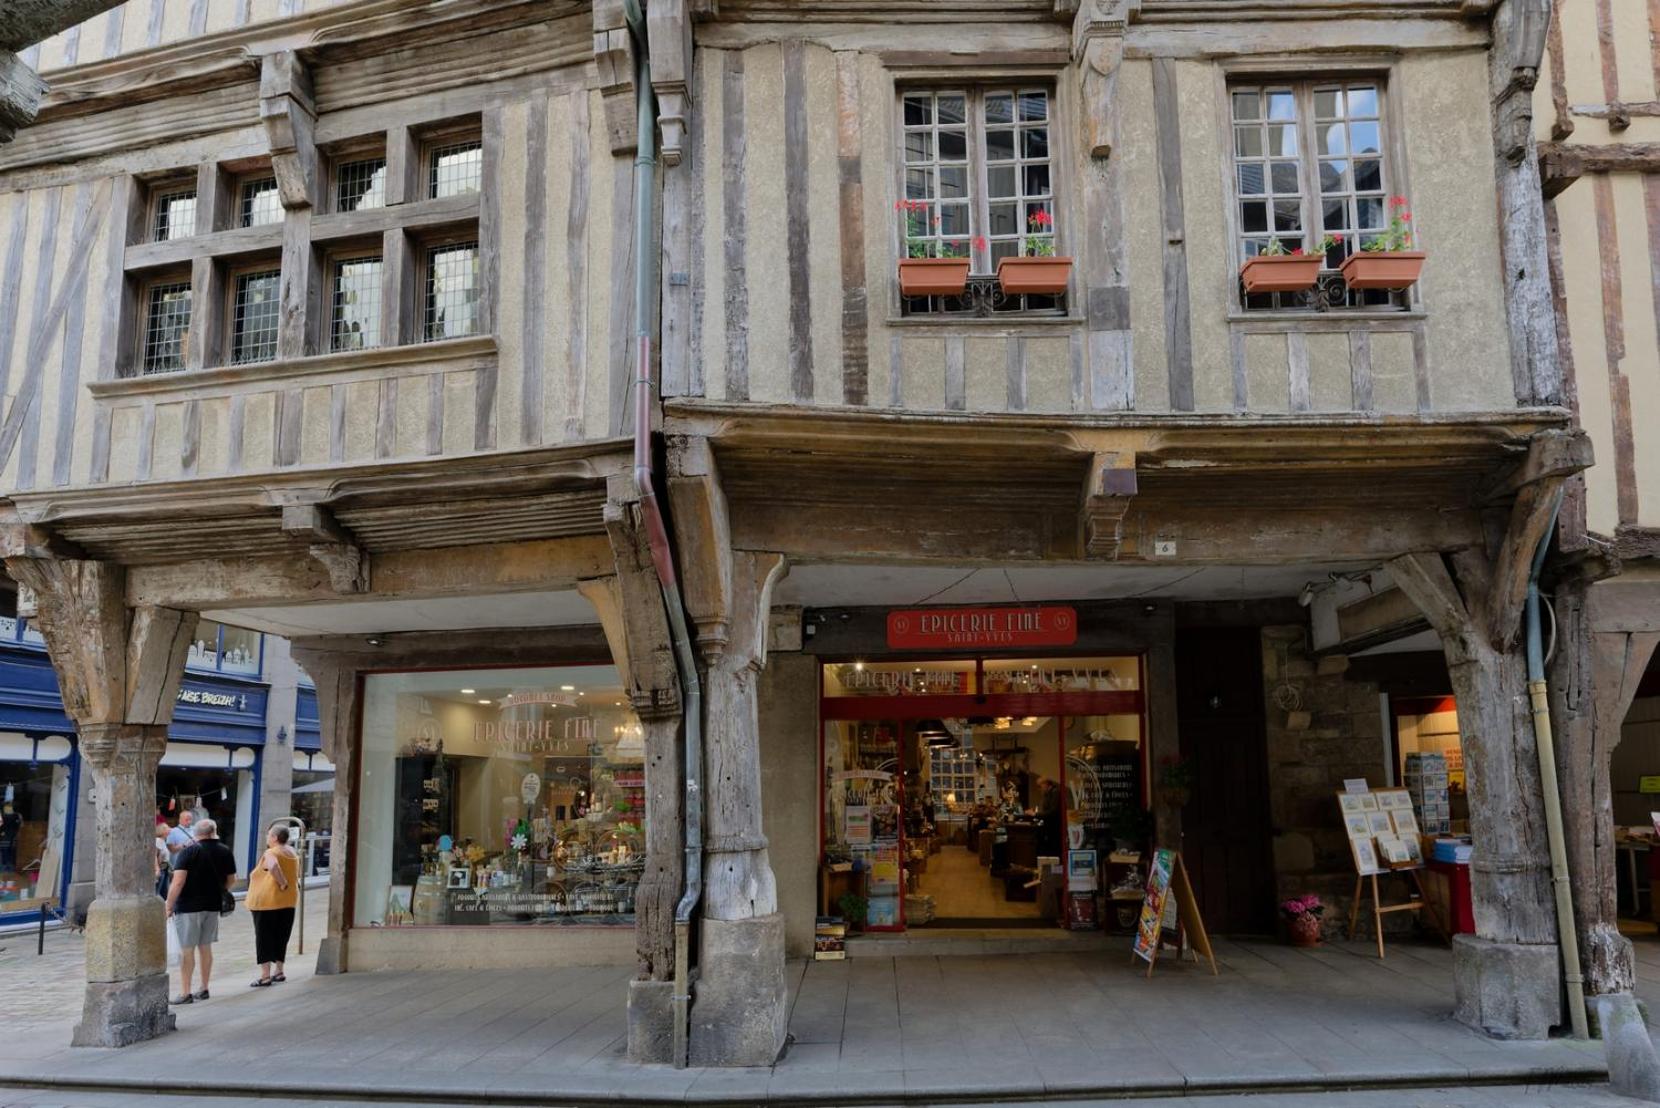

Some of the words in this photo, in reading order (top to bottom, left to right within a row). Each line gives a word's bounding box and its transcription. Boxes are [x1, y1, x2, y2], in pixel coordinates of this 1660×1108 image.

[1162, 544, 1168, 552] 6
[920, 614, 996, 633] EPICERIE
[1007, 612, 1040, 631] FINE
[473, 719, 552, 741] EPICERIE
